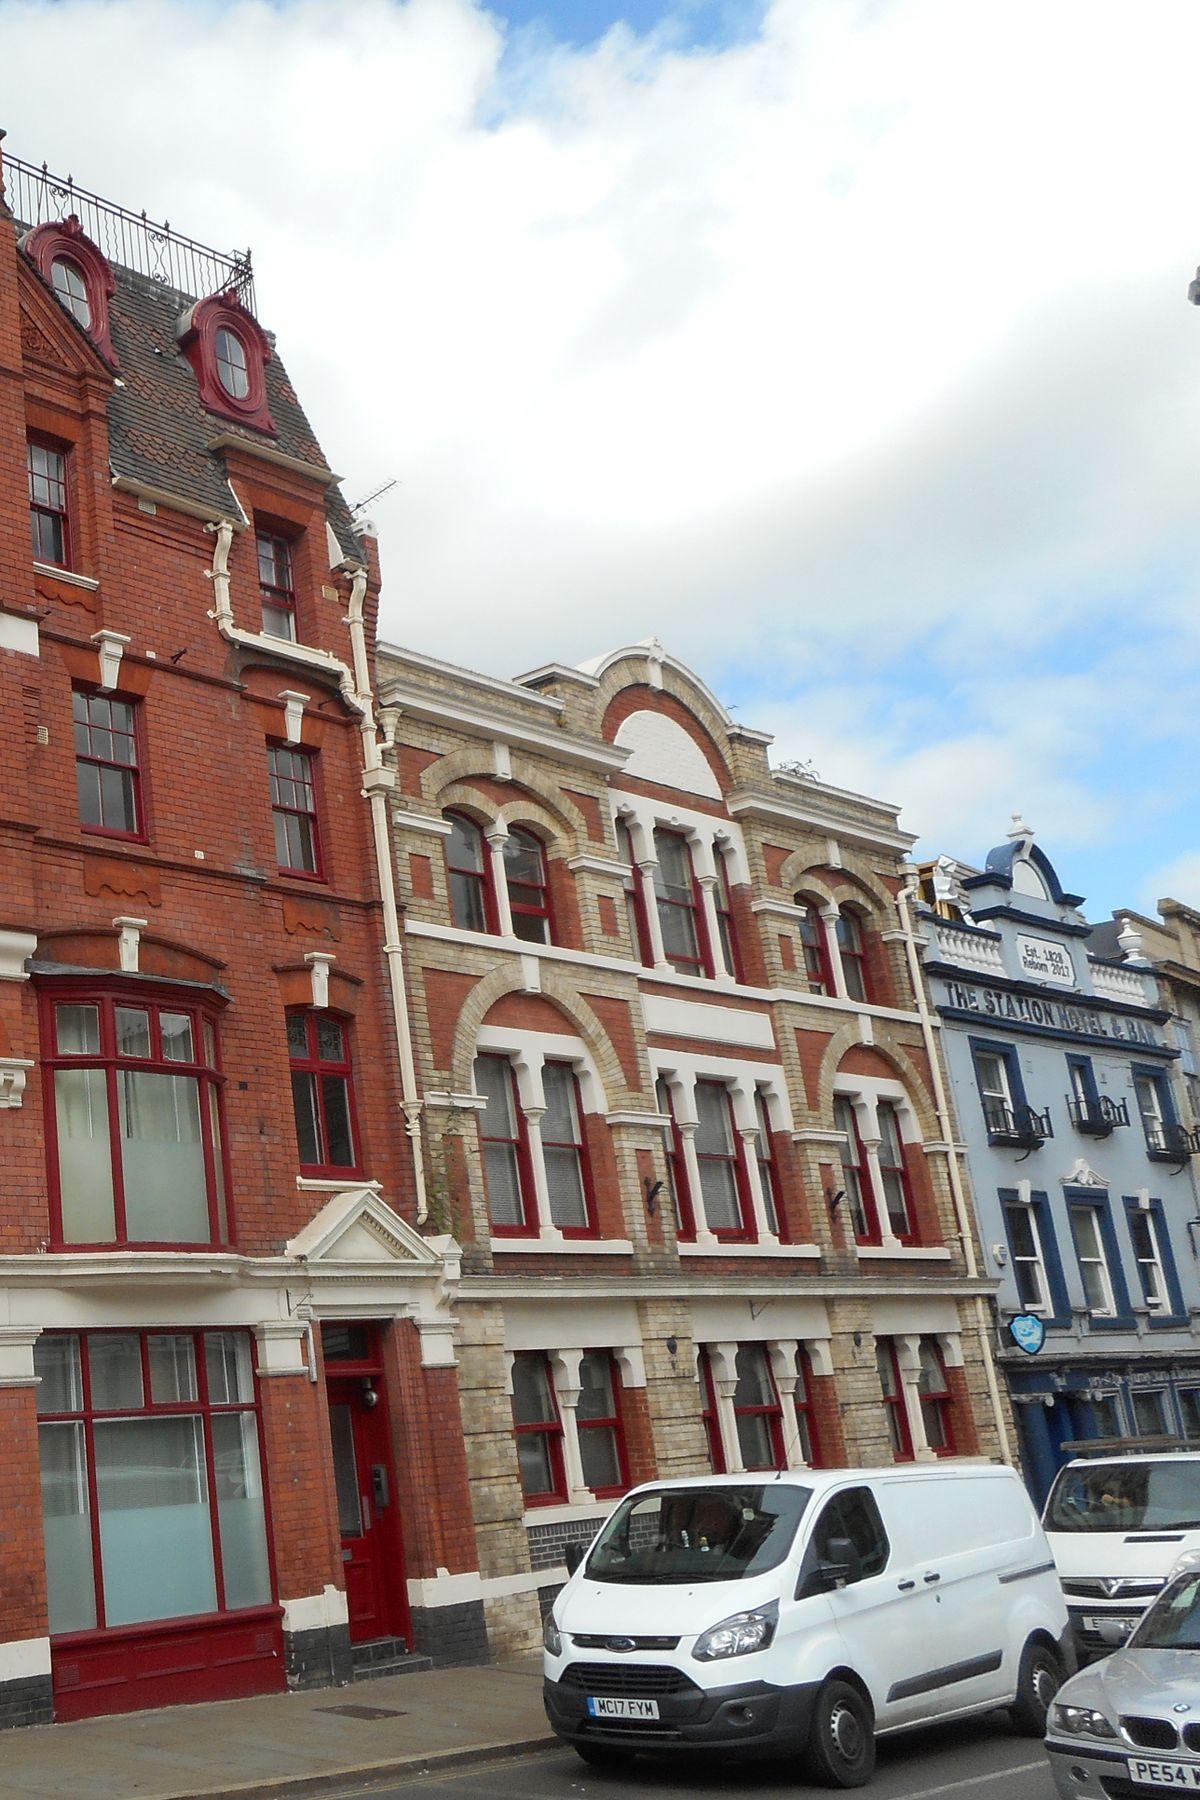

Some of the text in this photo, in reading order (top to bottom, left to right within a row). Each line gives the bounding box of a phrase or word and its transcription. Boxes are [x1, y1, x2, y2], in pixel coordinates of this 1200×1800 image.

[1024, 944, 1040, 959] Est.
[1022, 956, 1070, 978] Reborn 2017
[944, 981, 977, 1009] THE
[983, 989, 1056, 1026] STATION
[1058, 1004, 1108, 1036] HOTEL
[1125, 1018, 1158, 1047] BAR
[598, 1699, 654, 1716] MC17 FYM
[1136, 1761, 1188, 1785] PE54
